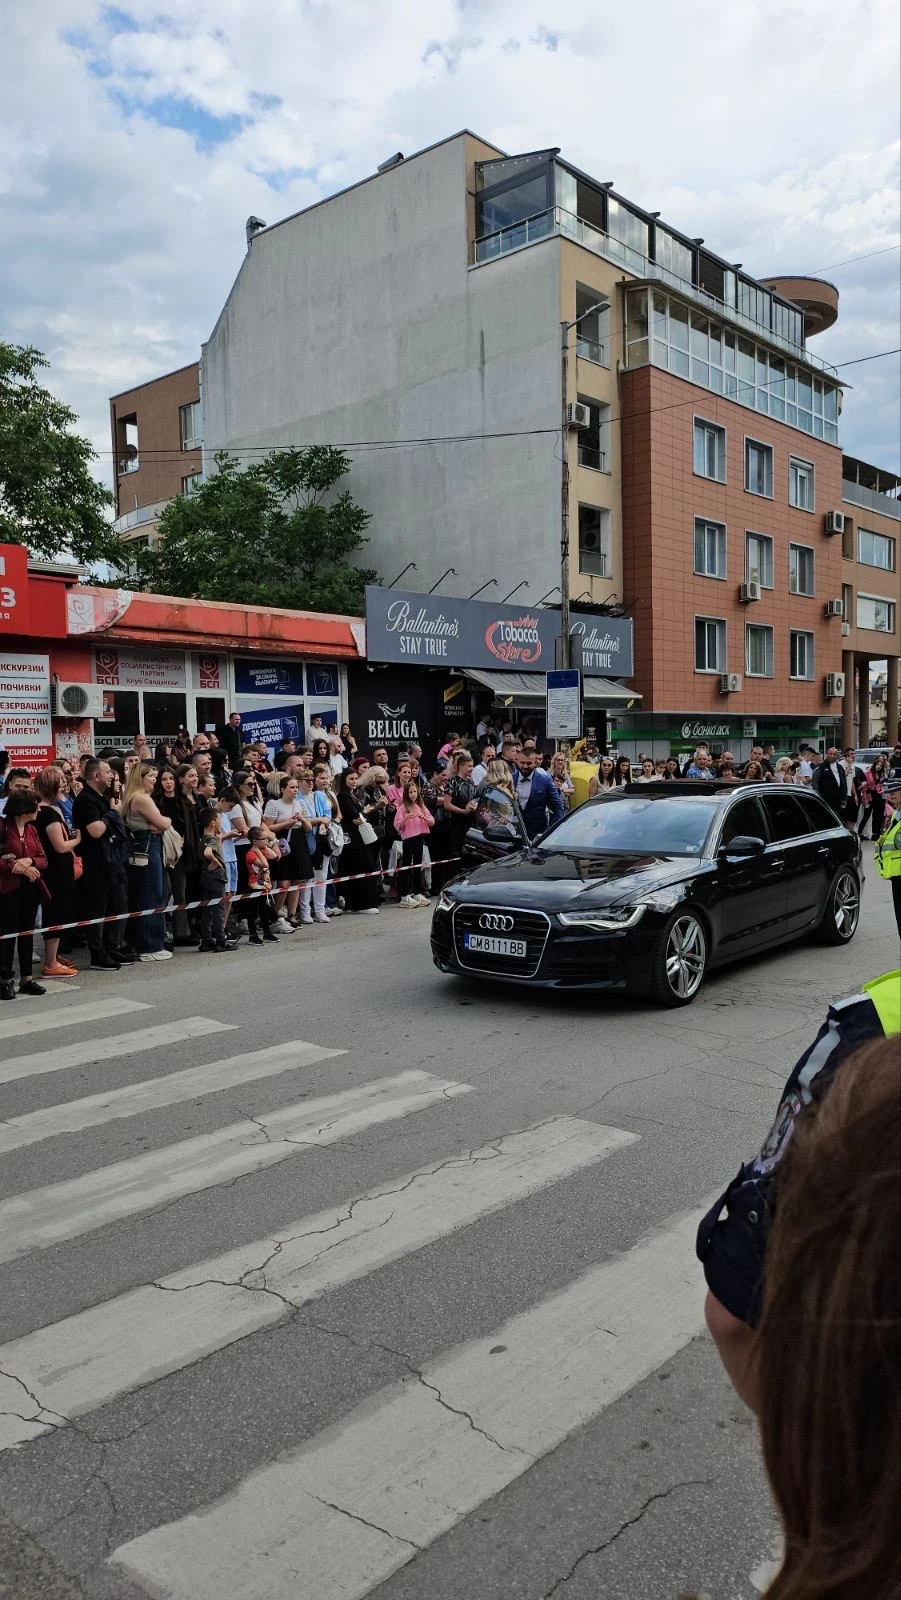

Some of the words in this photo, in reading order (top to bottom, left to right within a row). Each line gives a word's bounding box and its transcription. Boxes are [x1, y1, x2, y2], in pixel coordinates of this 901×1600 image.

[386, 600, 459, 637] Ballantine's
[497, 621, 538, 643] Tobacco
[400, 635, 421, 654] STAY
[425, 638, 447, 656] TRUE
[582, 652, 593, 667] TAY
[595, 652, 611, 668] TRUE
[0, 664, 44, 672] КСКУРЗИИ
[121, 662, 183, 671] СОЦИАЛИСТИЧЕСКА
[96, 675, 119, 685] БСП
[126, 678, 142, 686] Клуб
[200, 680, 220, 689] БСП
[0, 683, 41, 691] ПОЧИВКИ
[0, 702, 49, 711] ЕЗЕРВАЦИИ
[0, 718, 48, 726] АМОЛЕТНИ
[242, 718, 280, 732] ДЕМОКРАТИ
[6, 727, 40, 735] БИЛЕТИ
[368, 720, 418, 738] BELUGA
